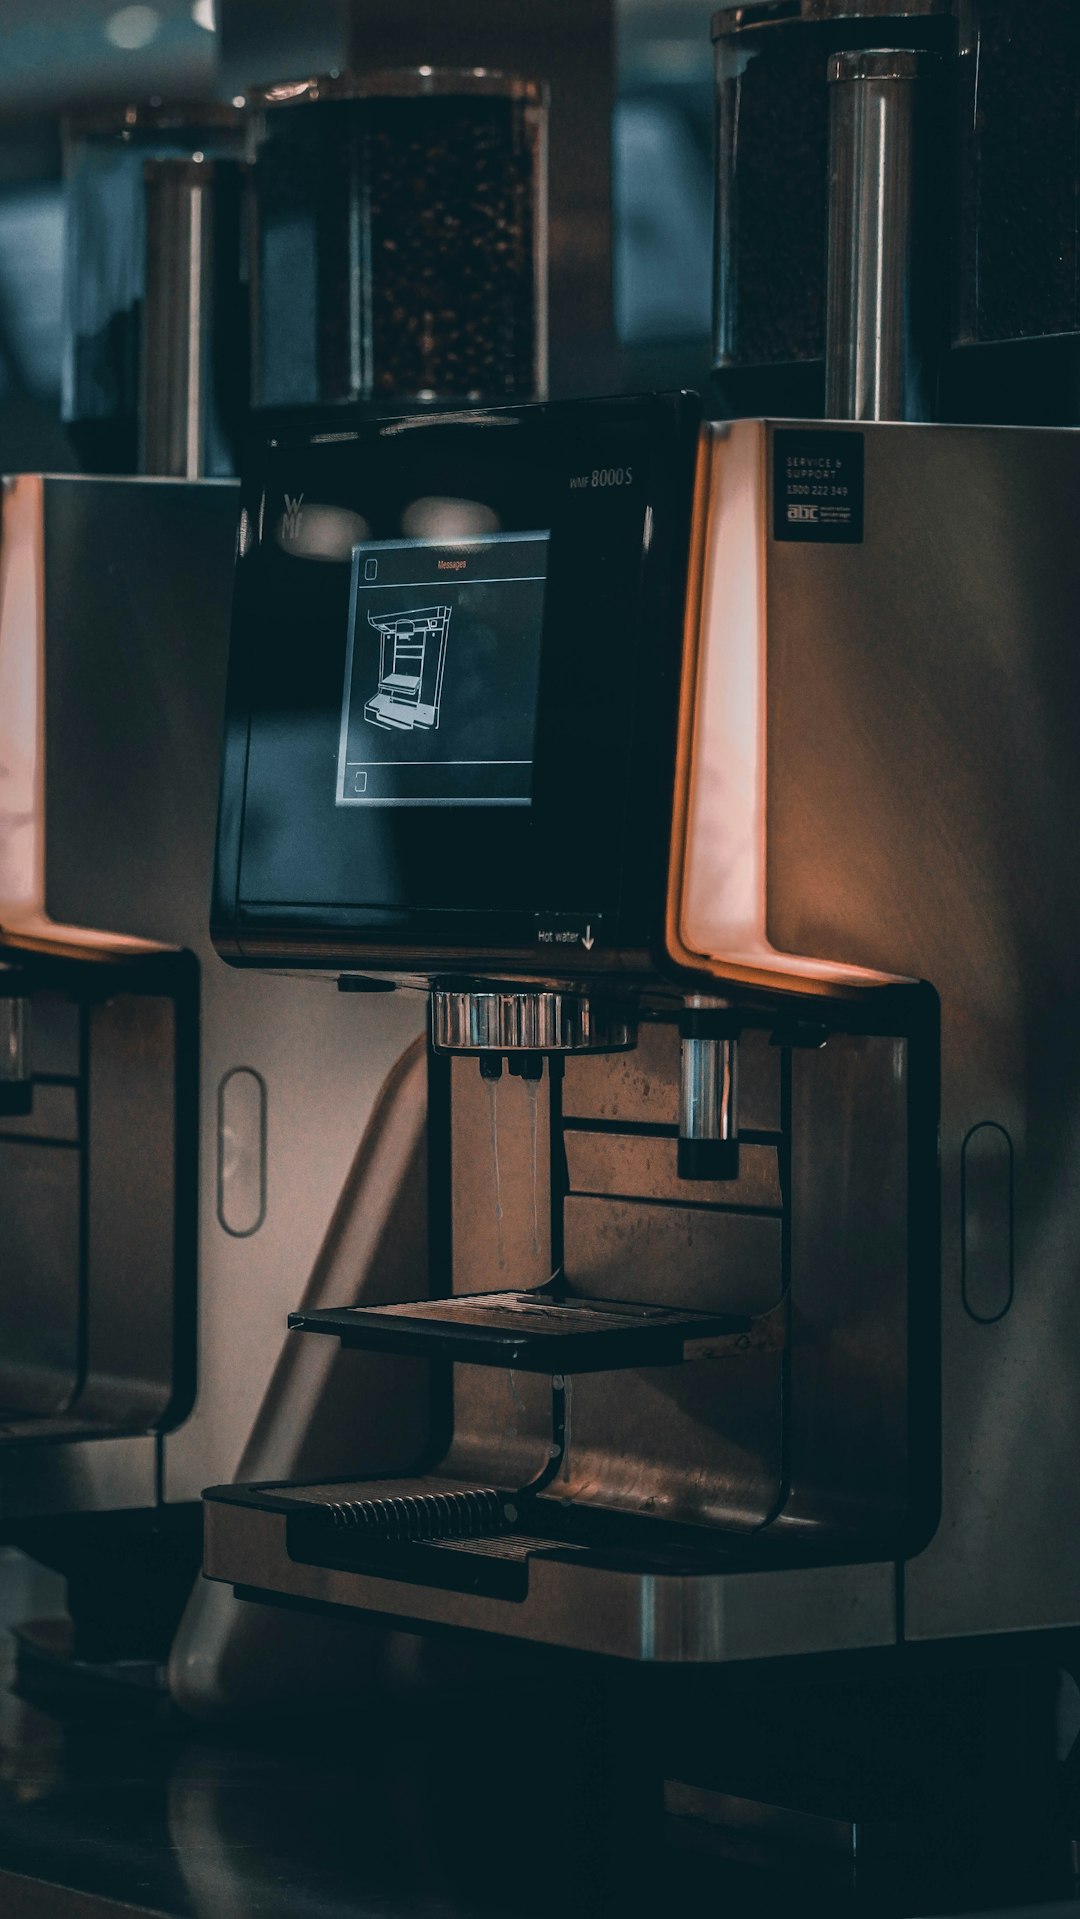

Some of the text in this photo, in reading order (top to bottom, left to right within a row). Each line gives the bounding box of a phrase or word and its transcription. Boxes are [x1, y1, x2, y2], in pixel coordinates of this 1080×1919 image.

[786, 457, 831, 468] SERVICE
[786, 469, 836, 479] SUPPORT
[569, 476, 589, 488] WMF
[787, 485, 848, 496] 1300 222 349
[787, 506, 818, 519] abc
[437, 559, 467, 571] Messages
[538, 931, 579, 942] Hot water
